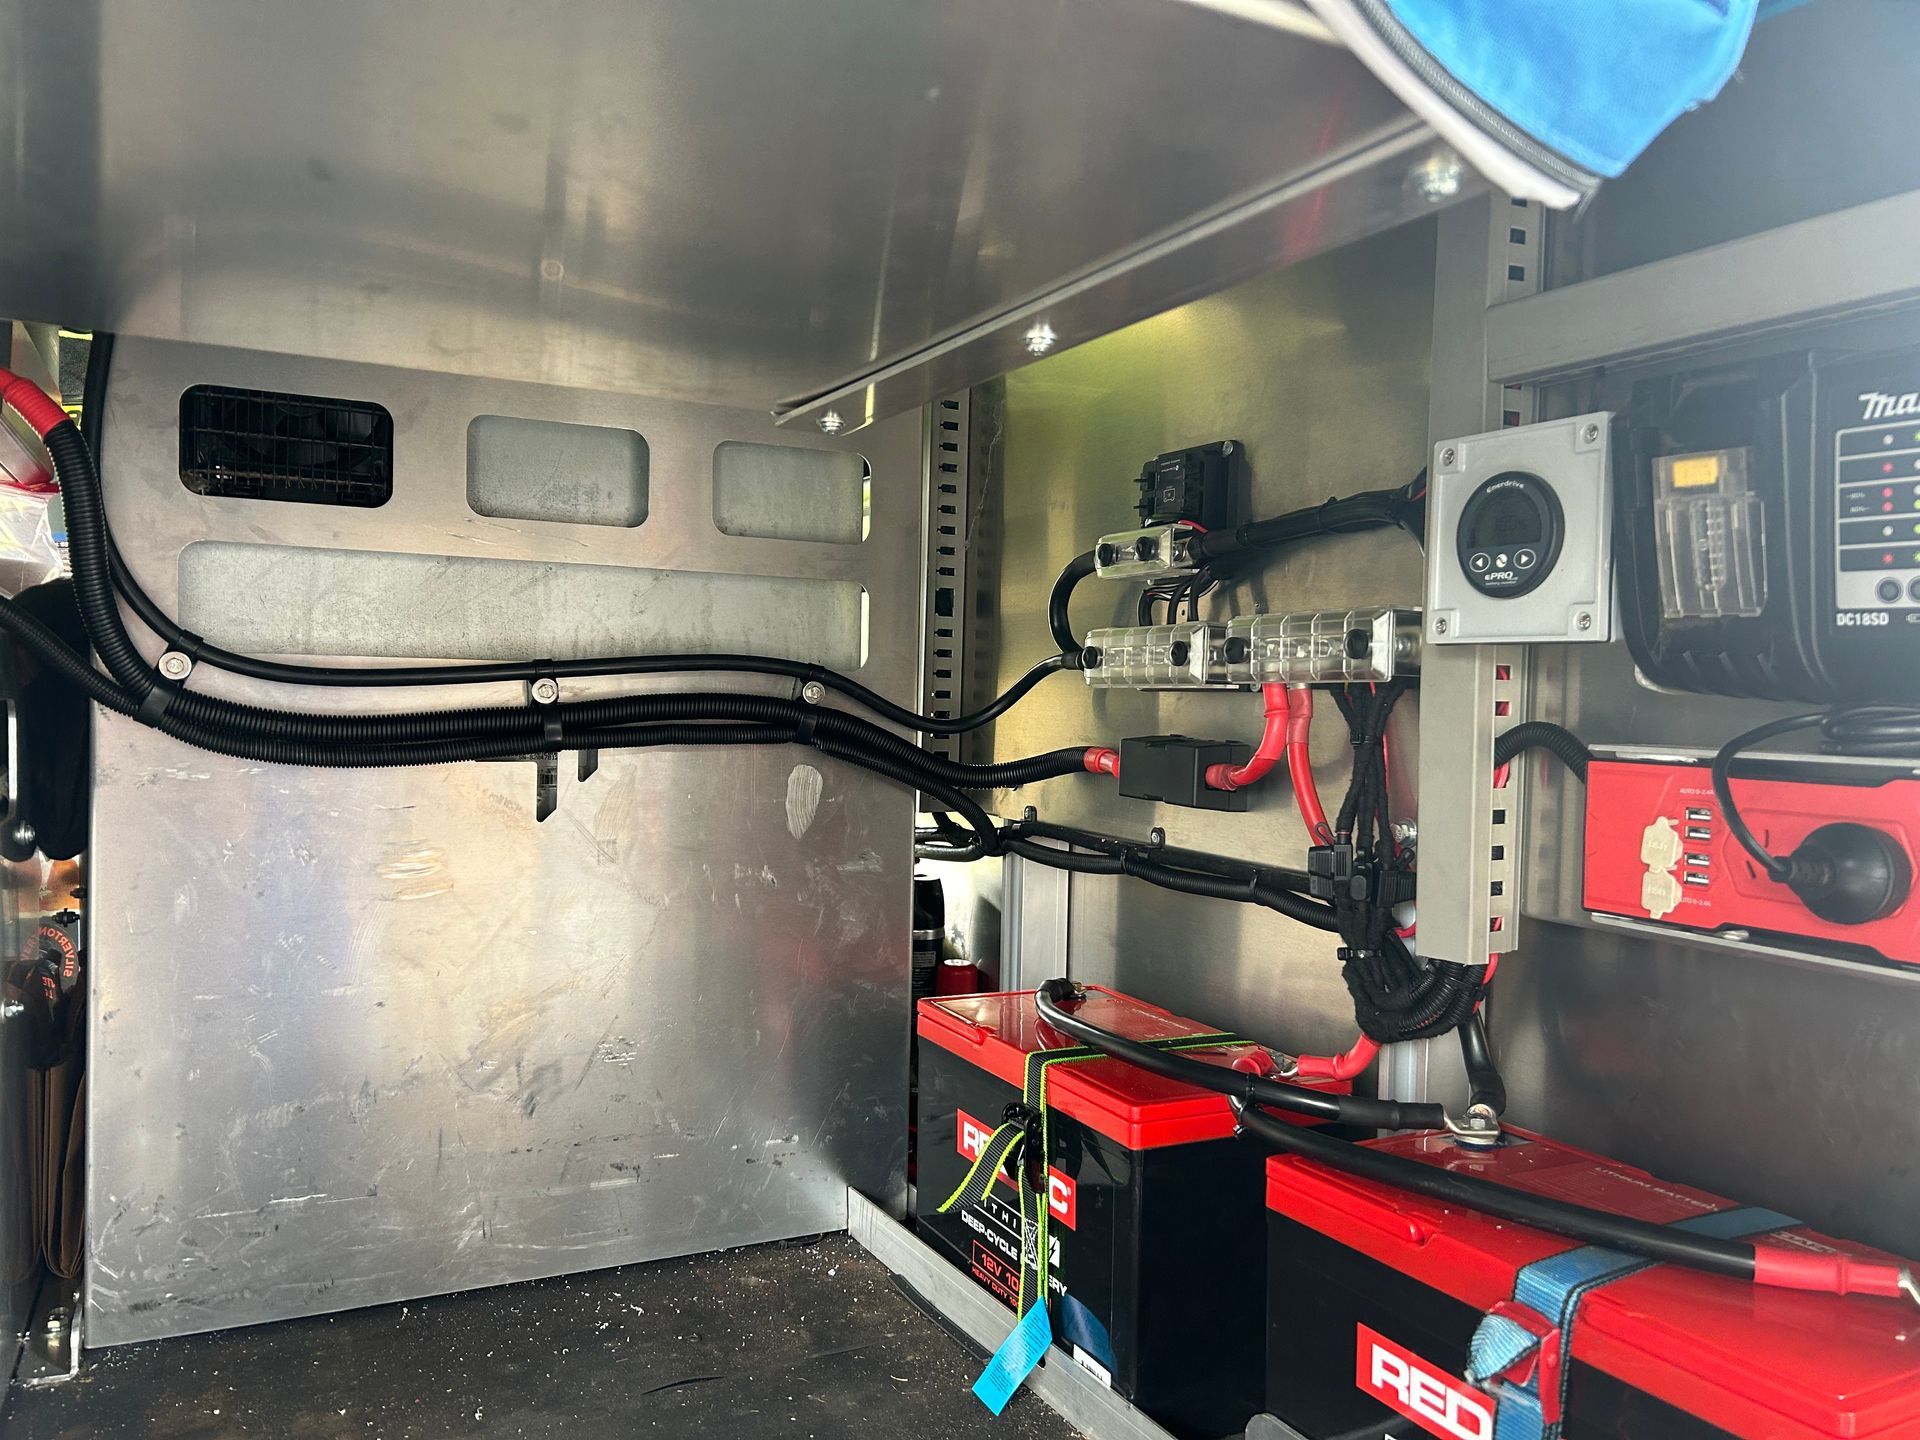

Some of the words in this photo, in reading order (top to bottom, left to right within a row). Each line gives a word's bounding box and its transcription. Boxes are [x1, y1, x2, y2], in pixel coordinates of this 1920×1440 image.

[1836, 612, 1890, 626] DC18SD
[981, 1253, 1002, 1277] 12V
[971, 1266, 991, 1285] HEAVY
[991, 1281, 1008, 1299] DUTY
